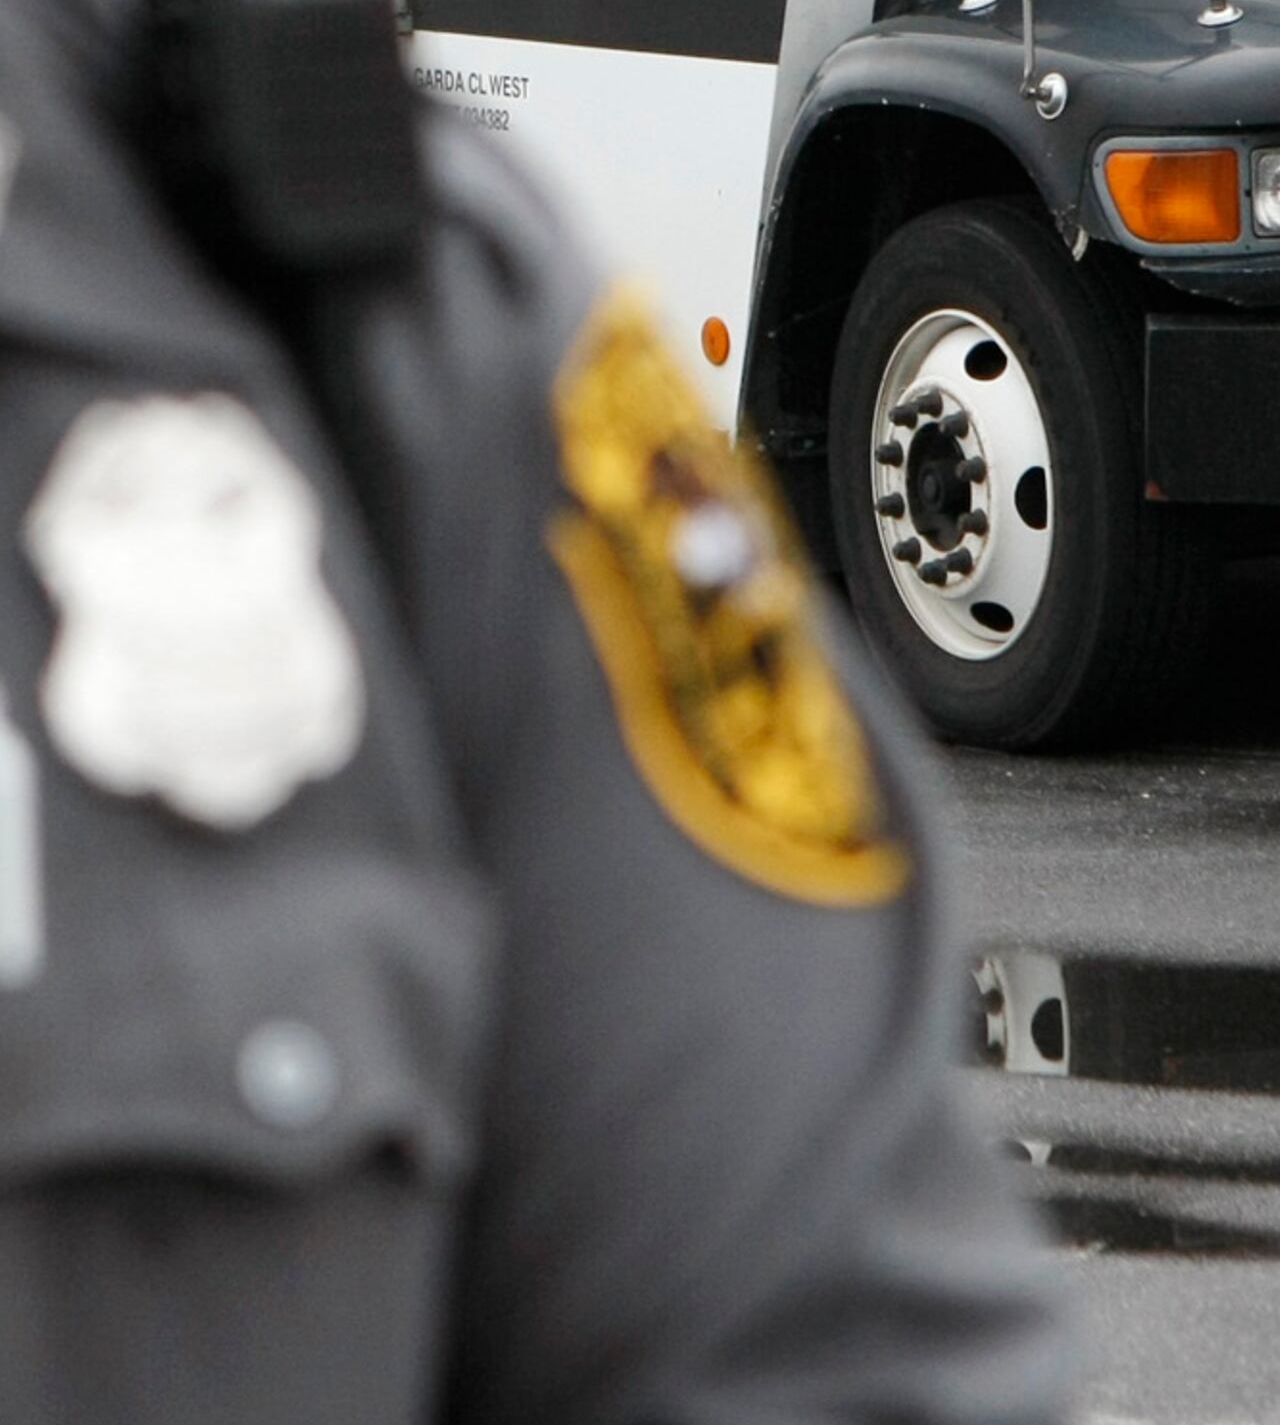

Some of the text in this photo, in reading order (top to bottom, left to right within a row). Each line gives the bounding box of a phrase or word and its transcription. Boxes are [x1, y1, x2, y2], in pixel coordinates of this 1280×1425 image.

[415, 68, 530, 100] GARDA CL WEST
